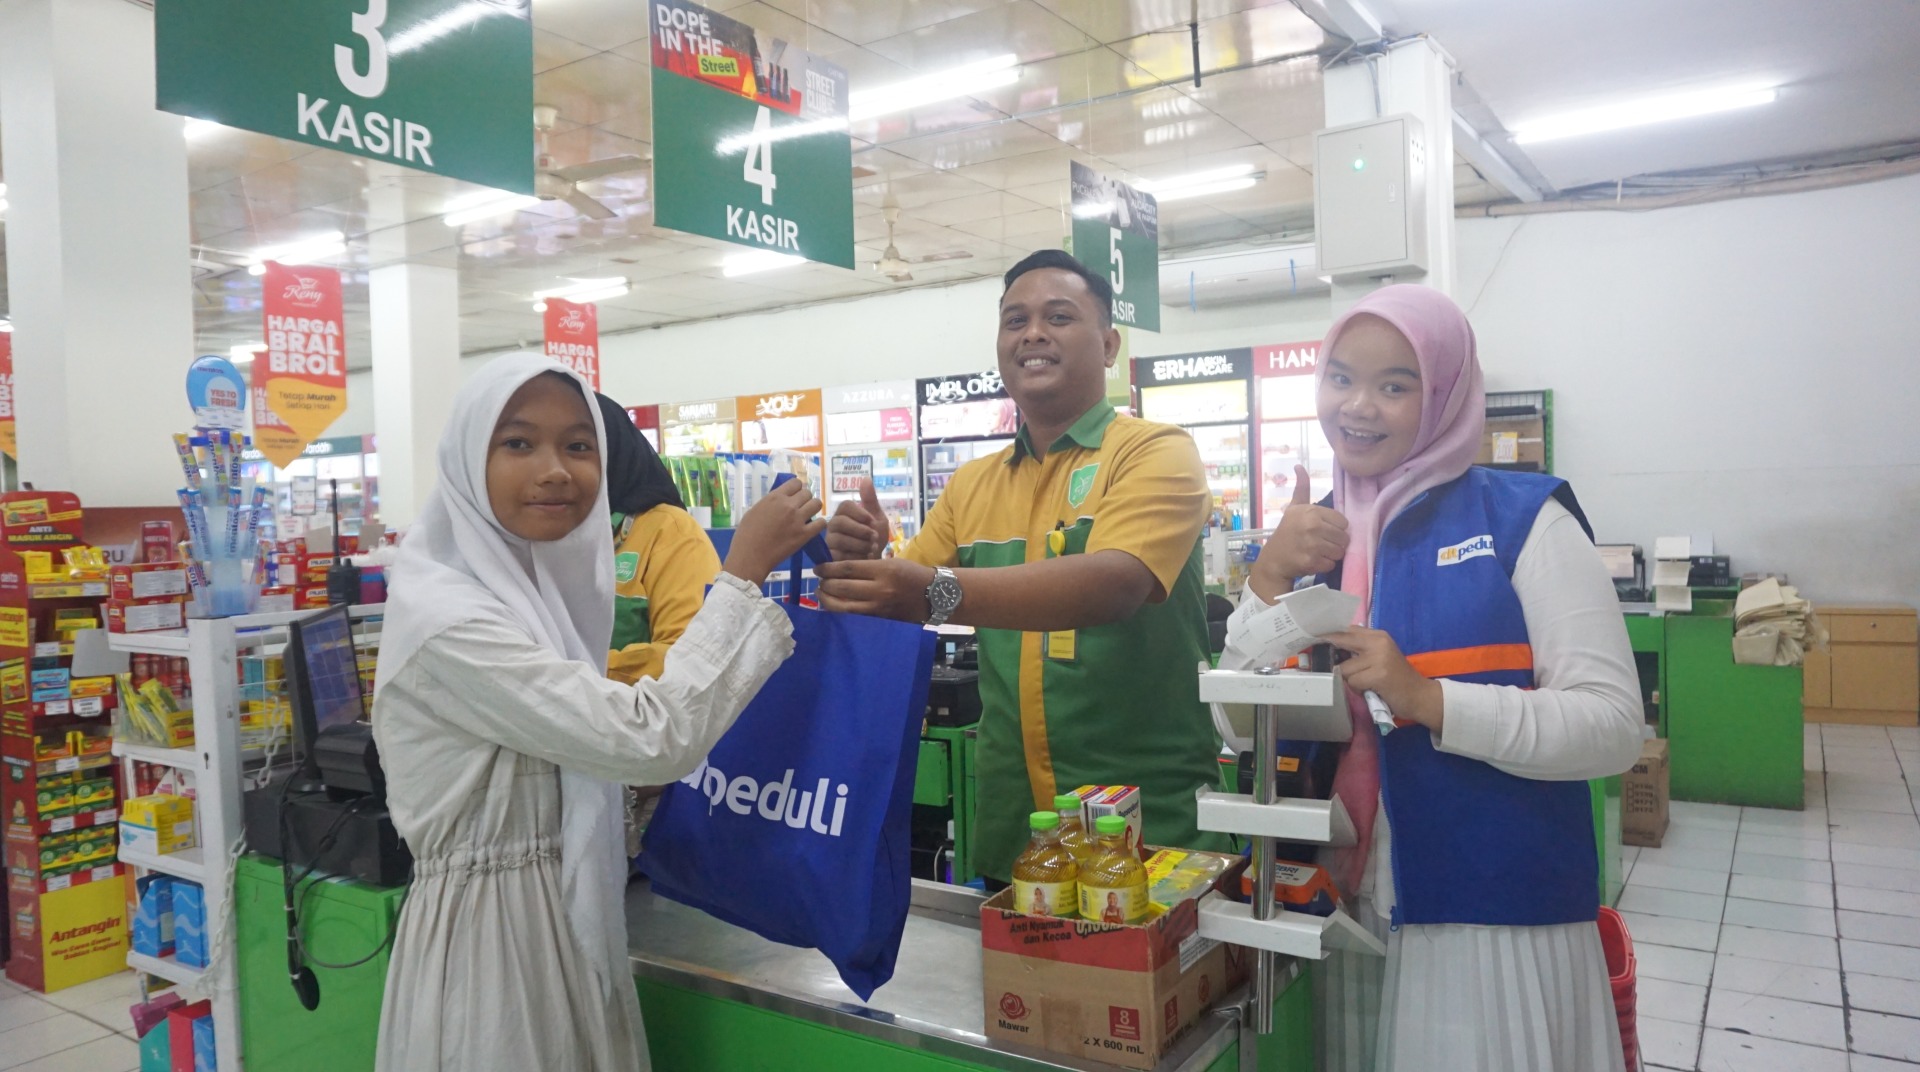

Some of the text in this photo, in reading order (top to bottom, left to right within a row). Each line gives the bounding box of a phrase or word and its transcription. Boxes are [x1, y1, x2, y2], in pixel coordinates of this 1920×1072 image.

[656, 4, 711, 36] DOPE
[334, 0, 388, 98] 3
[659, 28, 723, 57] IN THE
[700, 58, 736, 73] Street
[806, 69, 835, 97] STREET
[297, 92, 434, 167] KASIR
[744, 105, 776, 205] 4
[727, 205, 799, 251] KASIR
[1110, 227, 1124, 294] 5
[1112, 299, 1136, 323] ASIR
[267, 314, 339, 336] HARGA
[269, 330, 341, 356] BRAL
[547, 341, 595, 358] HARGA
[269, 351, 341, 376] BROL
[1153, 357, 1208, 381] ERHA
[1208, 363, 1234, 376] CARE
[1270, 348, 1318, 369] HAN
[210, 388, 237, 399] YES TO
[306, 391, 336, 402] Murah
[843, 388, 895, 403] AZZURA
[757, 394, 803, 416] YOU
[842, 456, 869, 464] PROMO
[836, 477, 863, 490] 28.80
[680, 756, 849, 837] peduli
[49, 916, 121, 945] Antangin
[1010, 920, 1065, 934] Anti Nyamuk
[1024, 931, 1071, 944] dan Kecoa
[999, 1020, 1030, 1033] Mawar
[1120, 1010, 1130, 1025] 8
[1093, 1037, 1102, 1047] X
[1103, 1039, 1123, 1051] 600
[1126, 1044, 1145, 1054] mL
